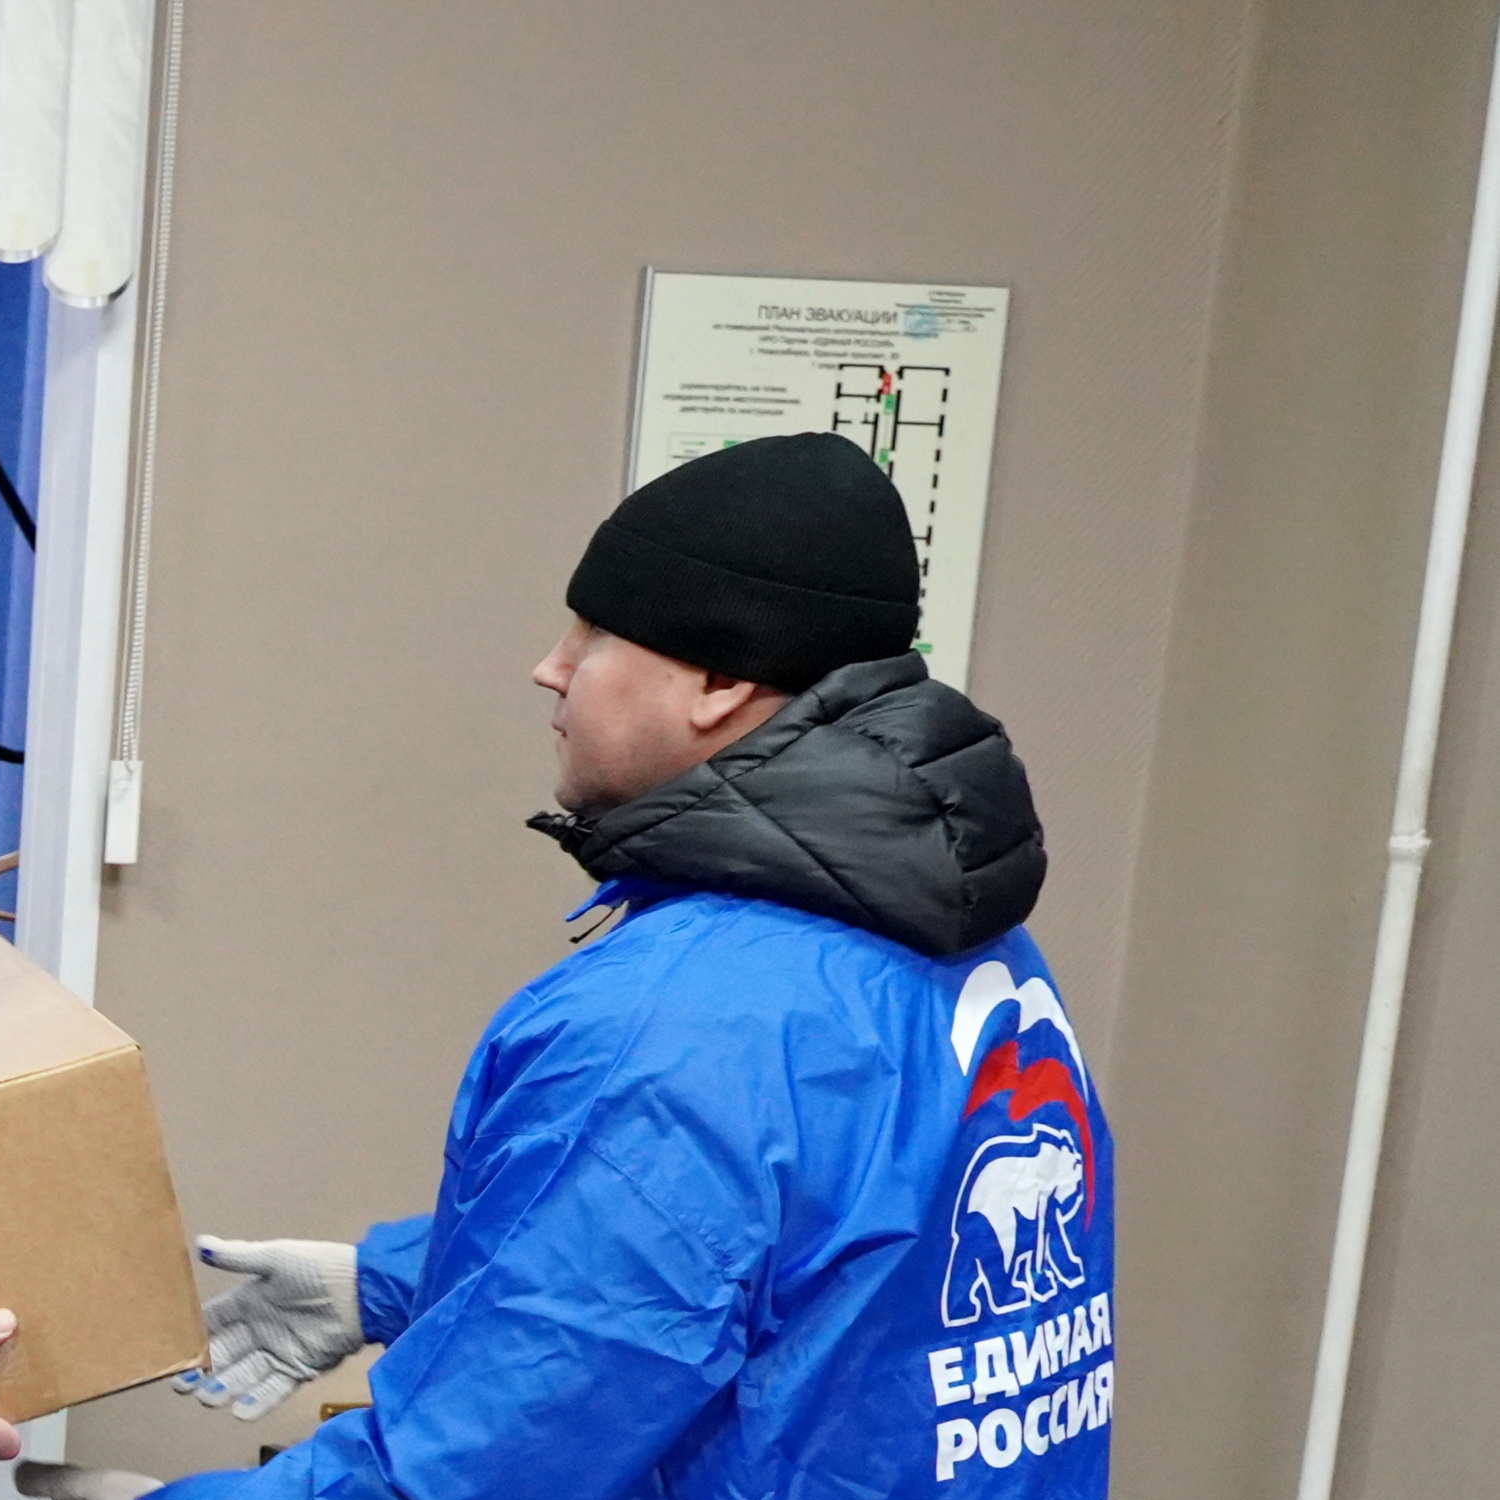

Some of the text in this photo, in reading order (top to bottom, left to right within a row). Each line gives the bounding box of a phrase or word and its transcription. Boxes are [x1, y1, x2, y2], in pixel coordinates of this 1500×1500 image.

[758, 305, 801, 320] ПЛАН
[804, 306, 898, 324] ЭВАКУАЦИИ
[928, 1292, 1112, 1406] ЕДИНАЯ
[935, 1360, 1114, 1482] РОССИЯ
